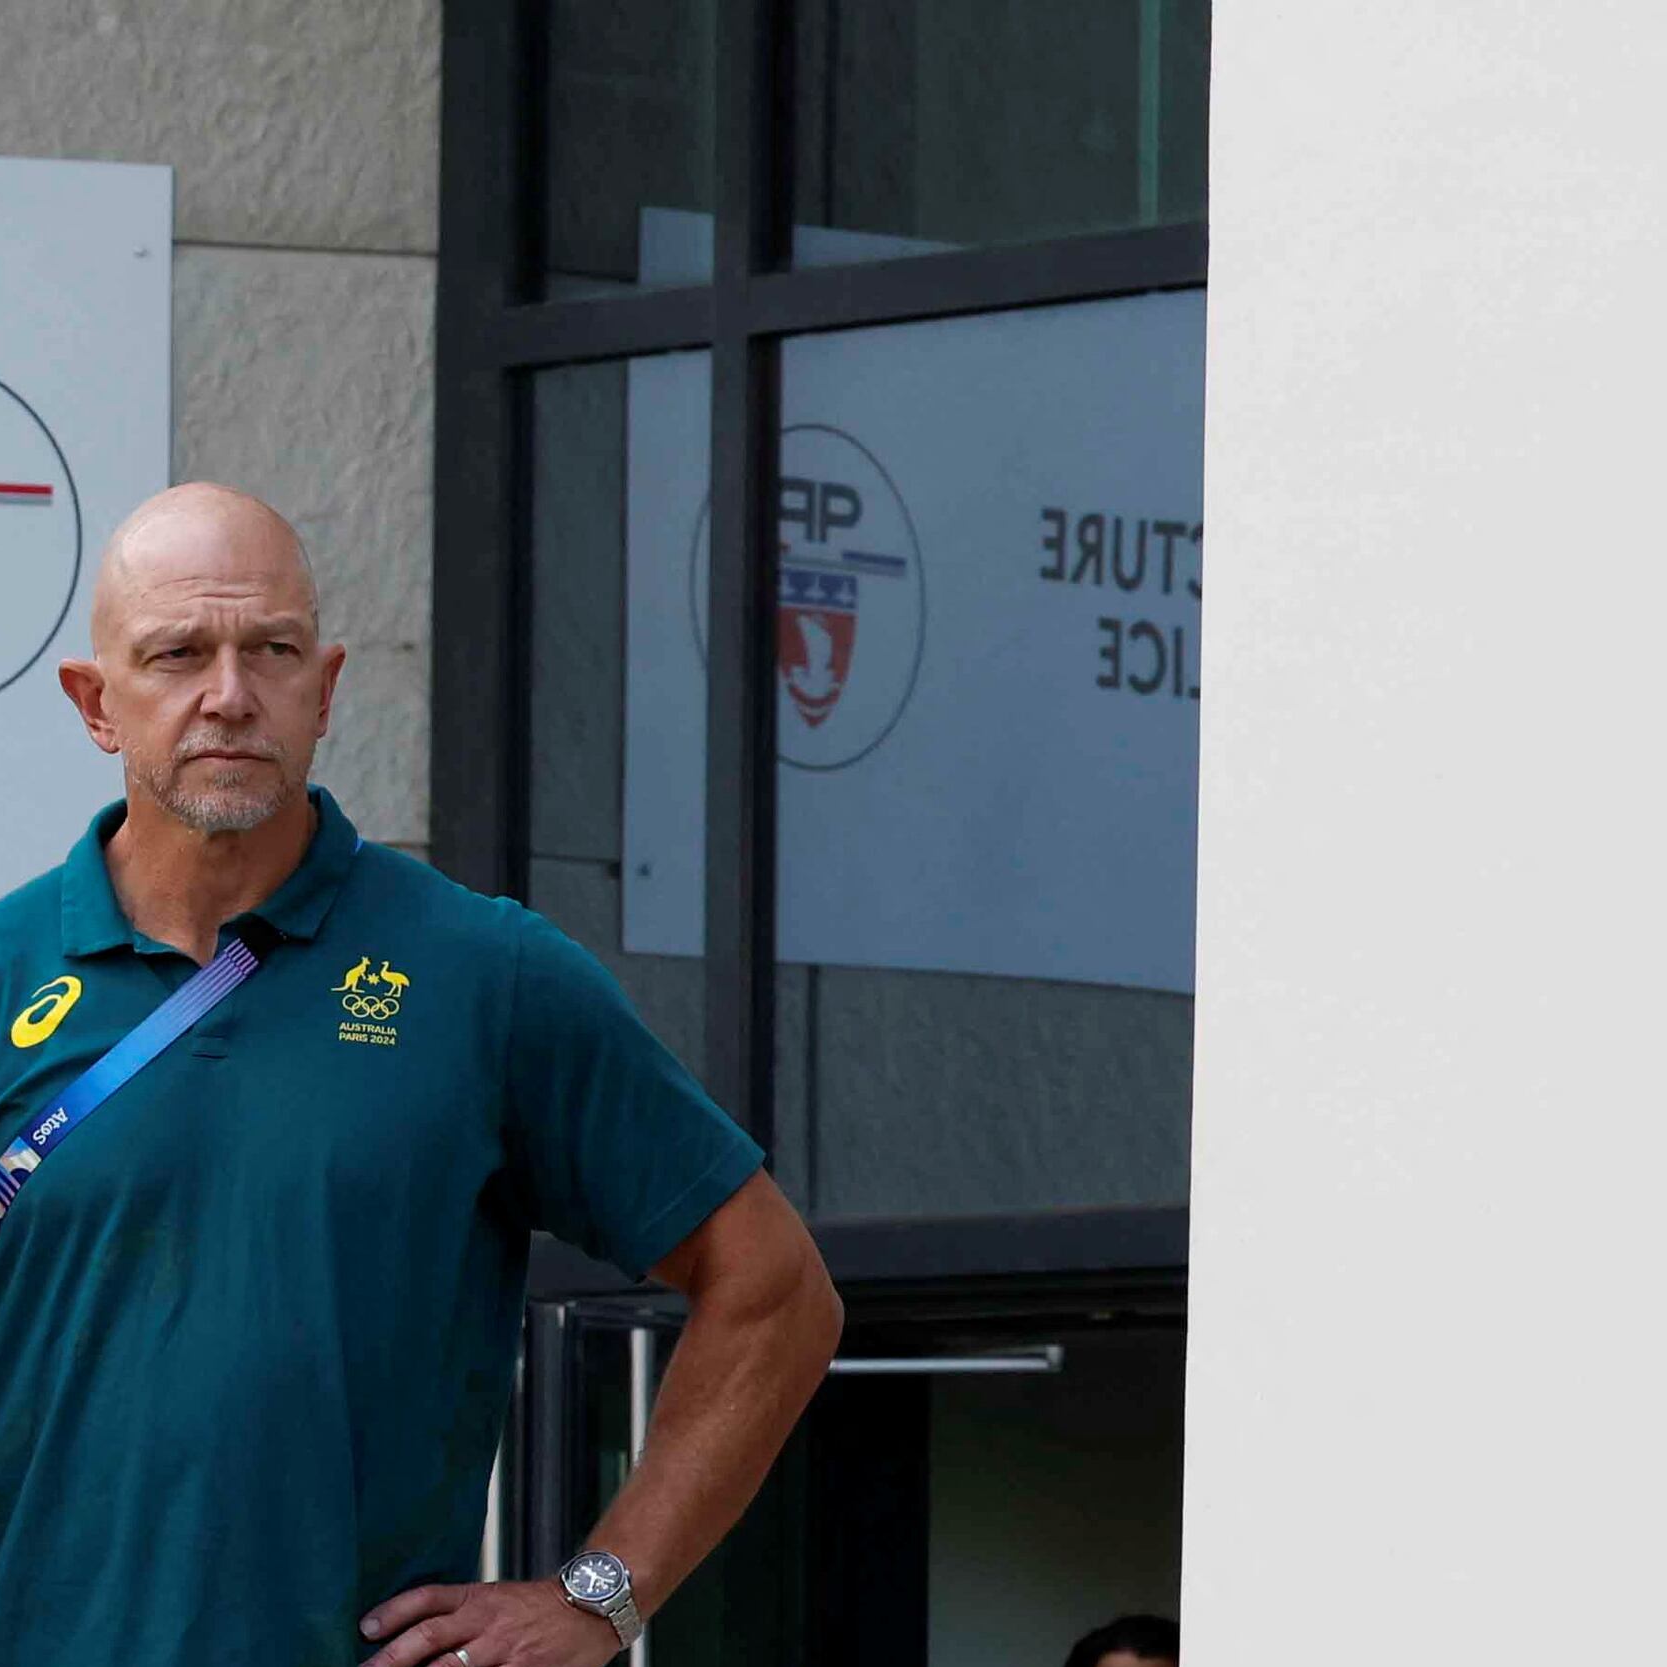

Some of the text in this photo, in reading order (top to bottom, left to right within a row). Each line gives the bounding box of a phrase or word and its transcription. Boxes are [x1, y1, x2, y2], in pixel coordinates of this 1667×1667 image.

[339, 1021, 397, 1036] AUSTRALIA
[338, 1032, 396, 1046] PARIS 2024
[33, 1107, 68, 1145] Atos
